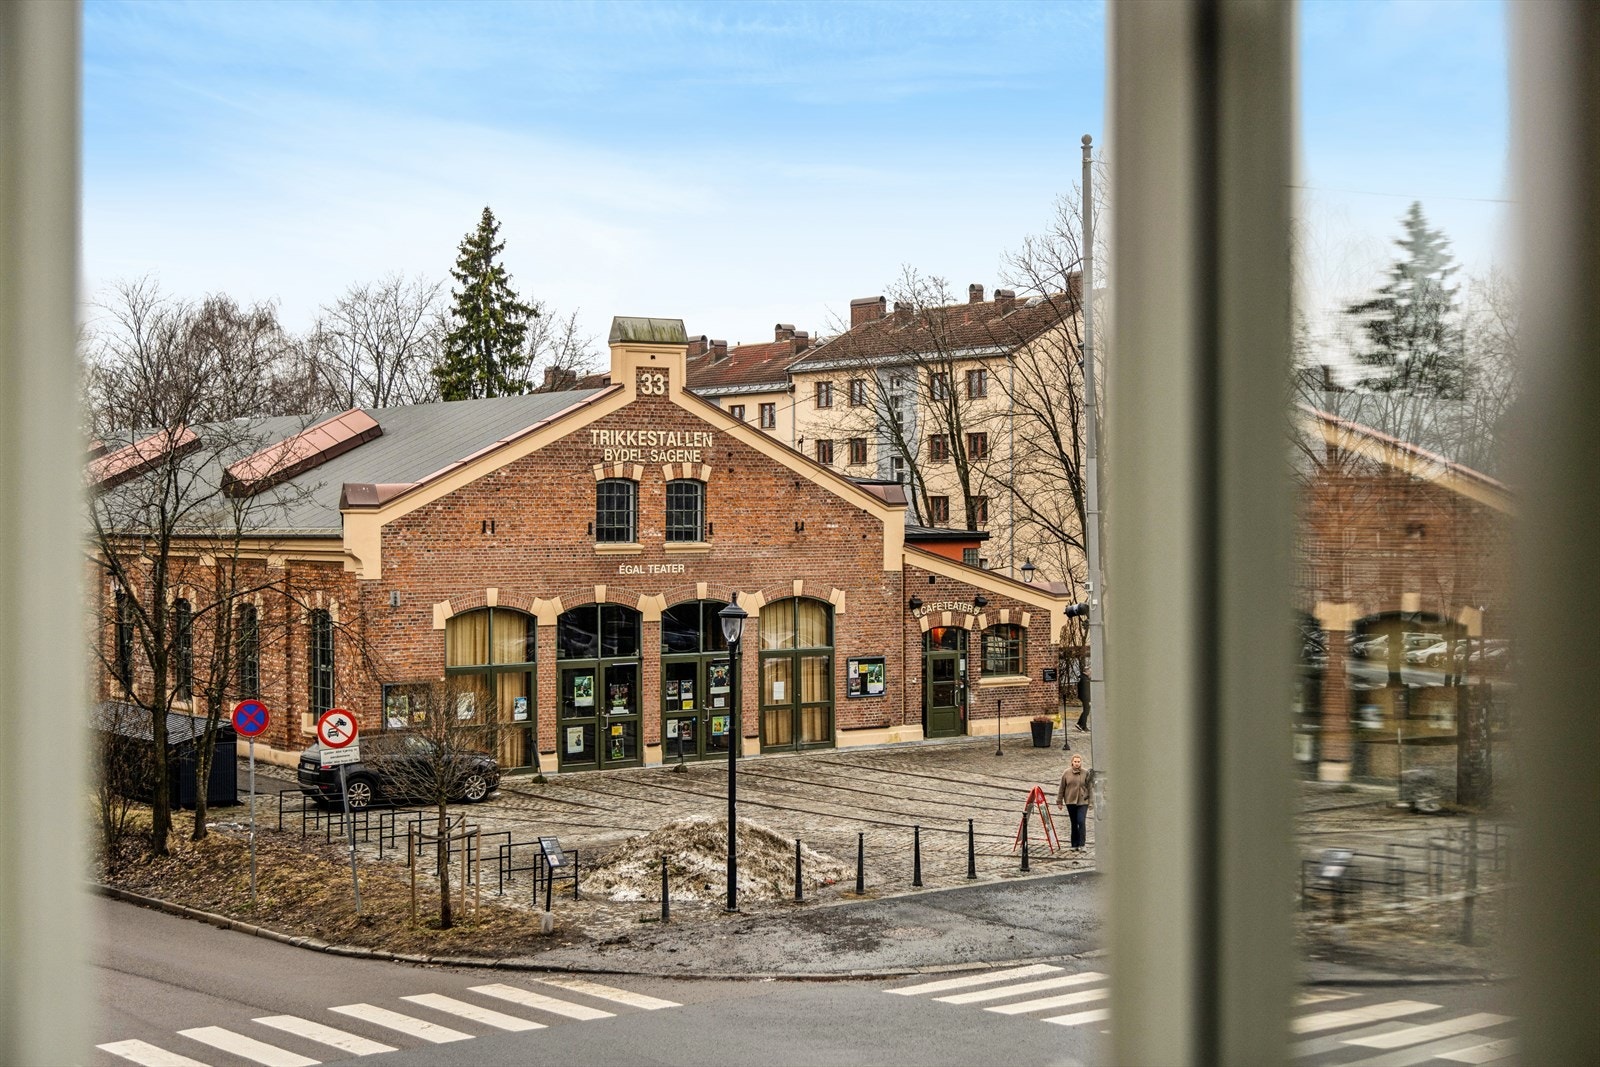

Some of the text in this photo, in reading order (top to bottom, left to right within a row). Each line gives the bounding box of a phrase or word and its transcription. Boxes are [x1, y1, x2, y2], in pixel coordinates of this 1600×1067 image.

[641, 373, 665, 395] 33
[590, 429, 713, 447] TRIKKESTALLEN
[604, 448, 701, 463] BYDEL SAGENE
[618, 562, 685, 574] ÉGAL TEATER
